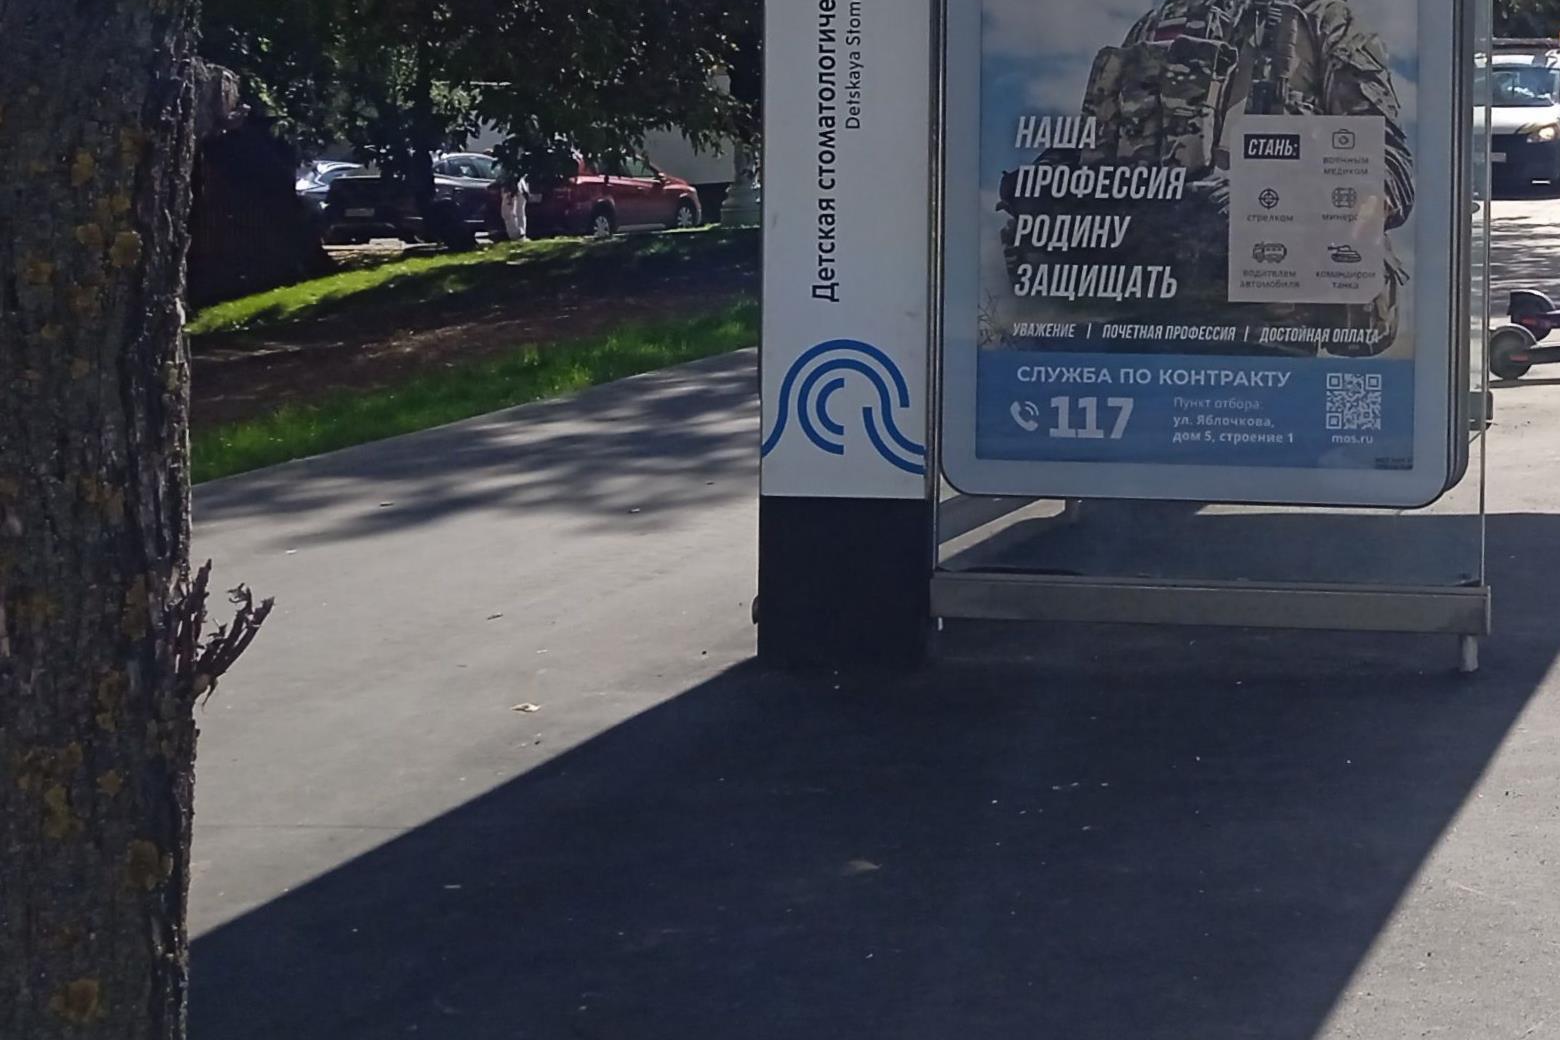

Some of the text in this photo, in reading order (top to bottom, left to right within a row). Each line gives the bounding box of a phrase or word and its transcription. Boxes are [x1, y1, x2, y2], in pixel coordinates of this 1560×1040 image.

[844, 50, 865, 130] Detskaya
[1014, 115, 1097, 149] НАША
[1248, 138, 1299, 157] СТАНЬ:
[1014, 165, 1187, 200] ПРОФЕССИЯ
[1014, 214, 1132, 251] РОДИНУ
[812, 198, 840, 303] Детская
[1014, 263, 1178, 301] ЗАЩИЩАТЬ
[1012, 322, 1077, 338] УВАЖЕНИЕ
[1102, 323, 1236, 341] ПОЧЕТНАЯ ПРОФЕССИЯ
[1259, 325, 1379, 344] ДОСТОЙНАЯ ОПЛАТА
[1017, 366, 1292, 387] СЛУЖБА ПО КОНТРАКТУ
[1173, 396, 1211, 411] Пункт
[1049, 396, 1135, 439] 117
[1173, 414, 1275, 428] ул. Яблочкова,
[1172, 430, 1294, 445] дом 5, строение 1
[1331, 435, 1374, 444] mos.ru
